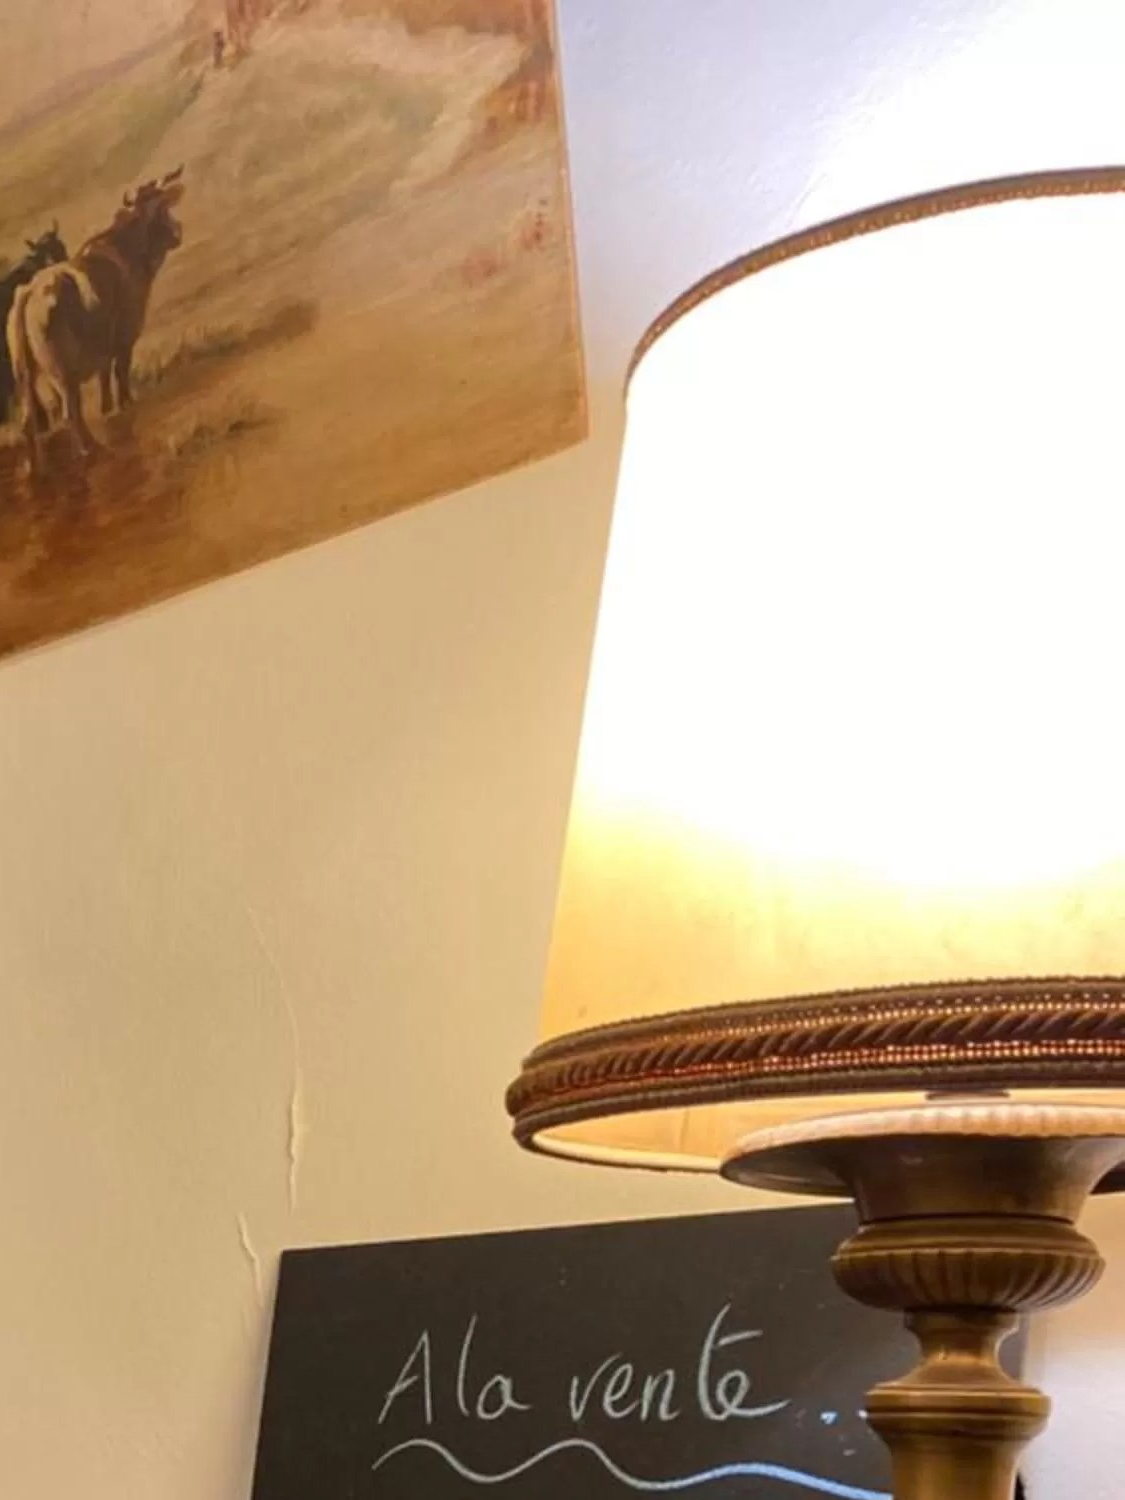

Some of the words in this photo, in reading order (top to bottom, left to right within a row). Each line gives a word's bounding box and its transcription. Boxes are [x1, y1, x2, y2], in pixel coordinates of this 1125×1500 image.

[375, 1330, 432, 1426] A
[455, 1312, 533, 1420] la
[570, 1302, 792, 1424] vente
